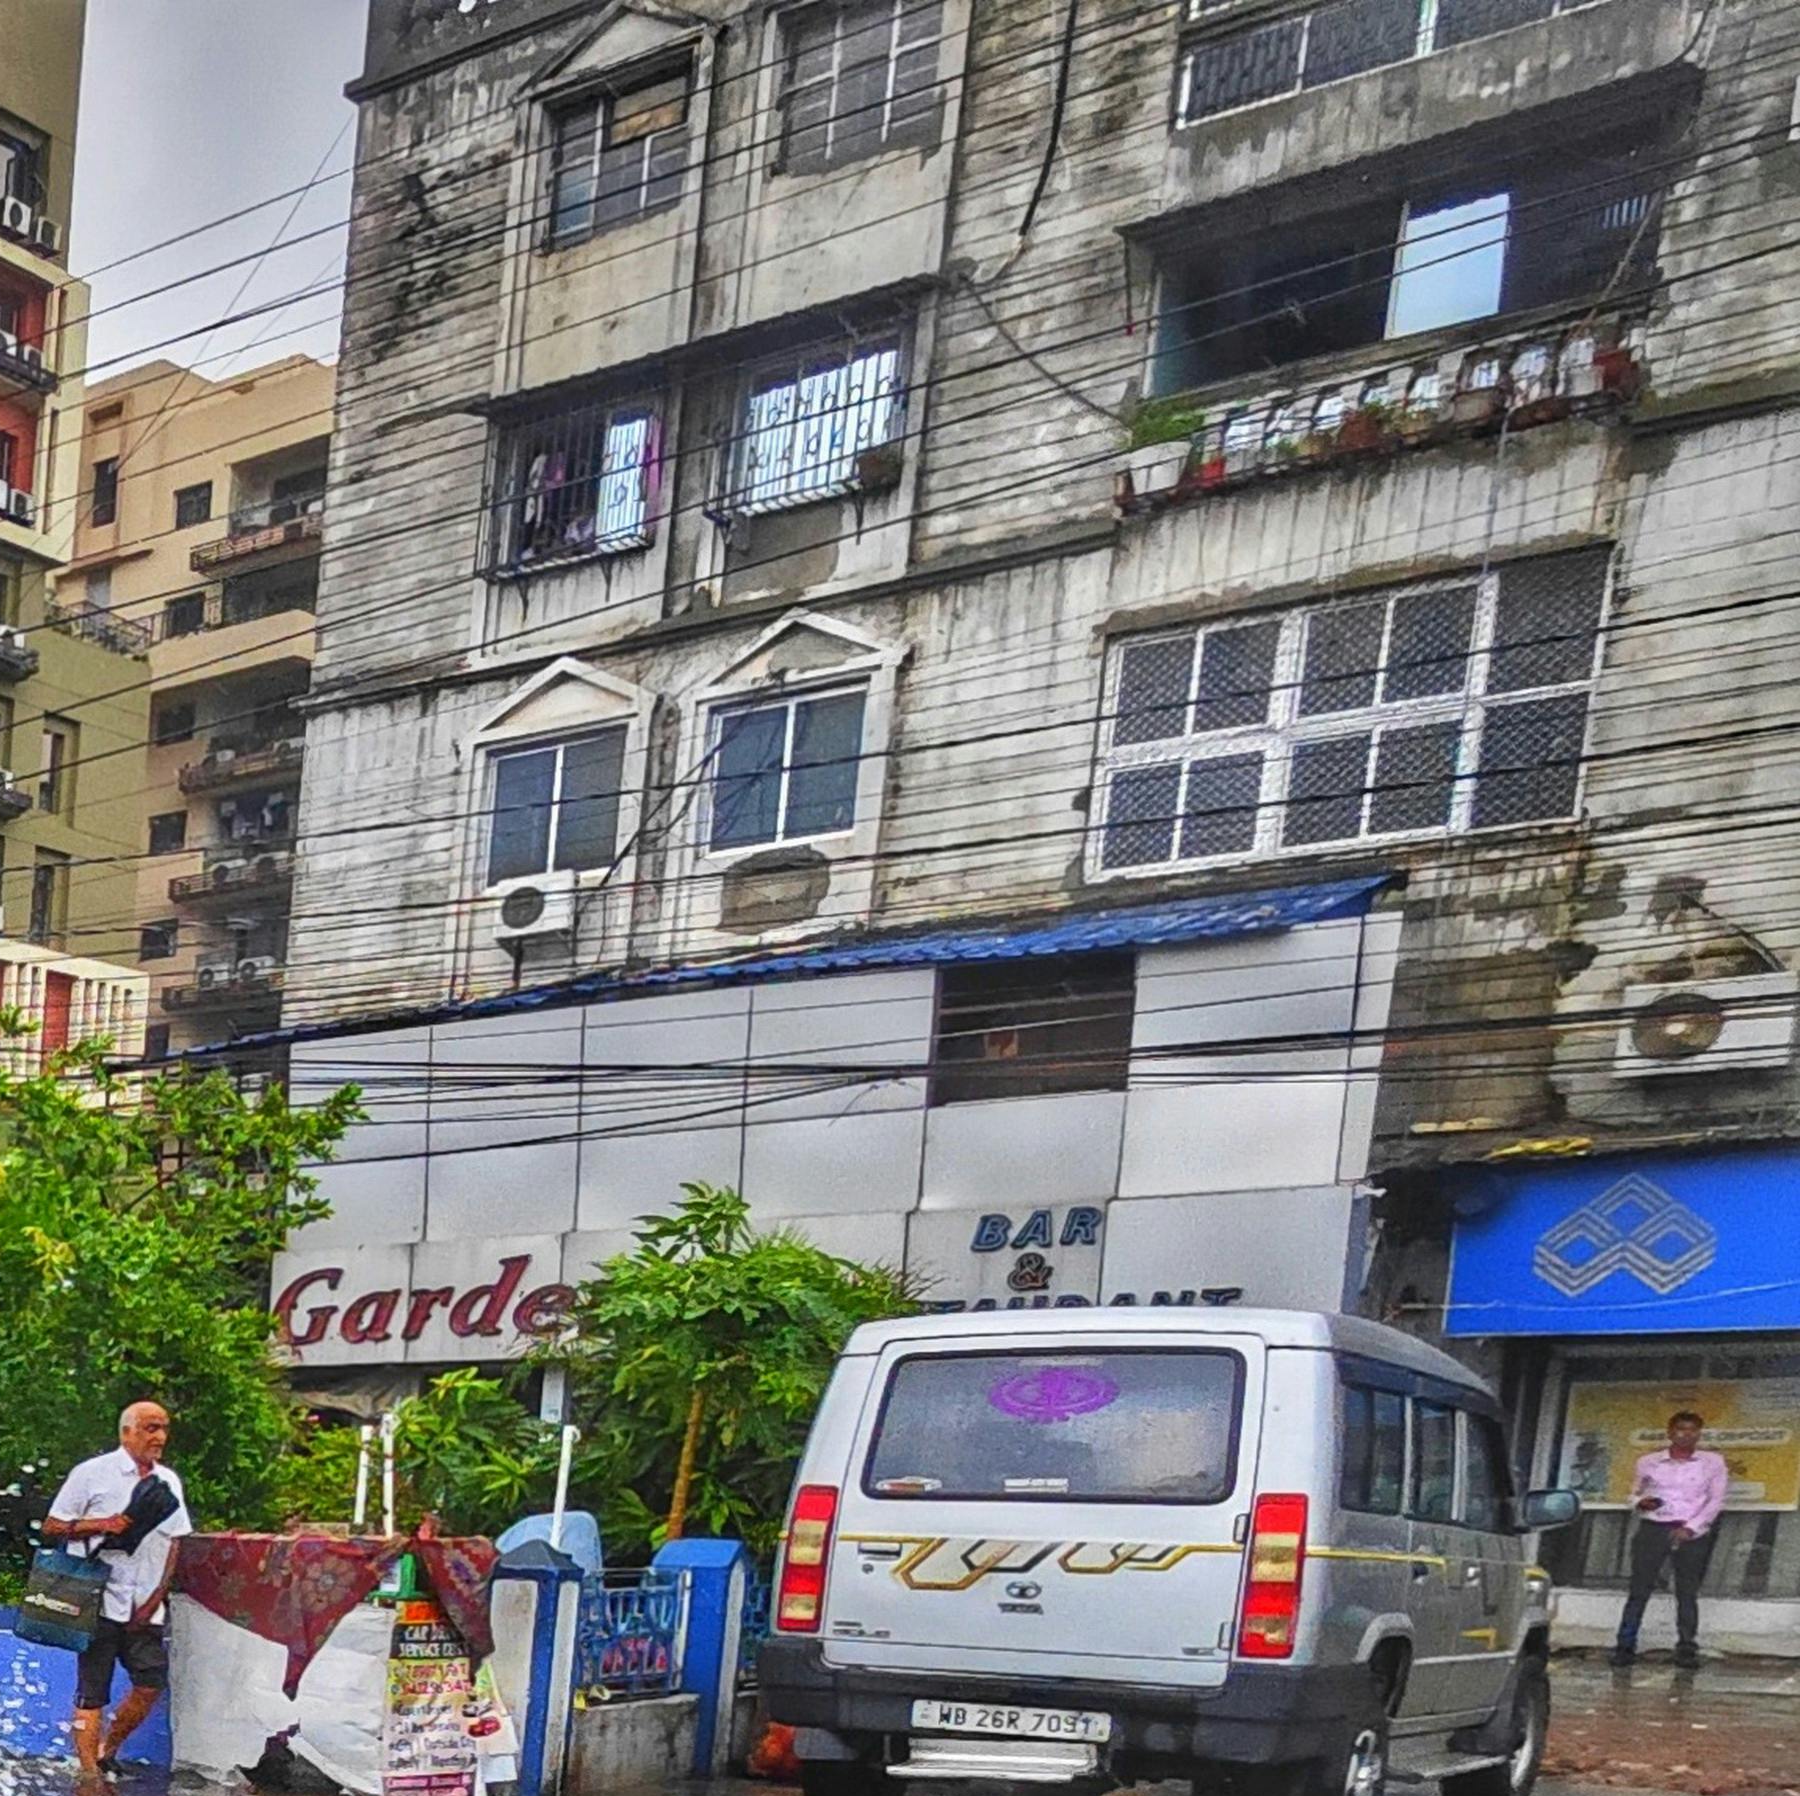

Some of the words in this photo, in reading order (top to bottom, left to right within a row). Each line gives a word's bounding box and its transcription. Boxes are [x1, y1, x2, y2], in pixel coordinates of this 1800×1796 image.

[970, 1206, 1103, 1252] BAR
[1007, 1252, 1054, 1291] &
[938, 1704, 967, 1726] WB
[976, 1708, 1021, 1730] 26R
